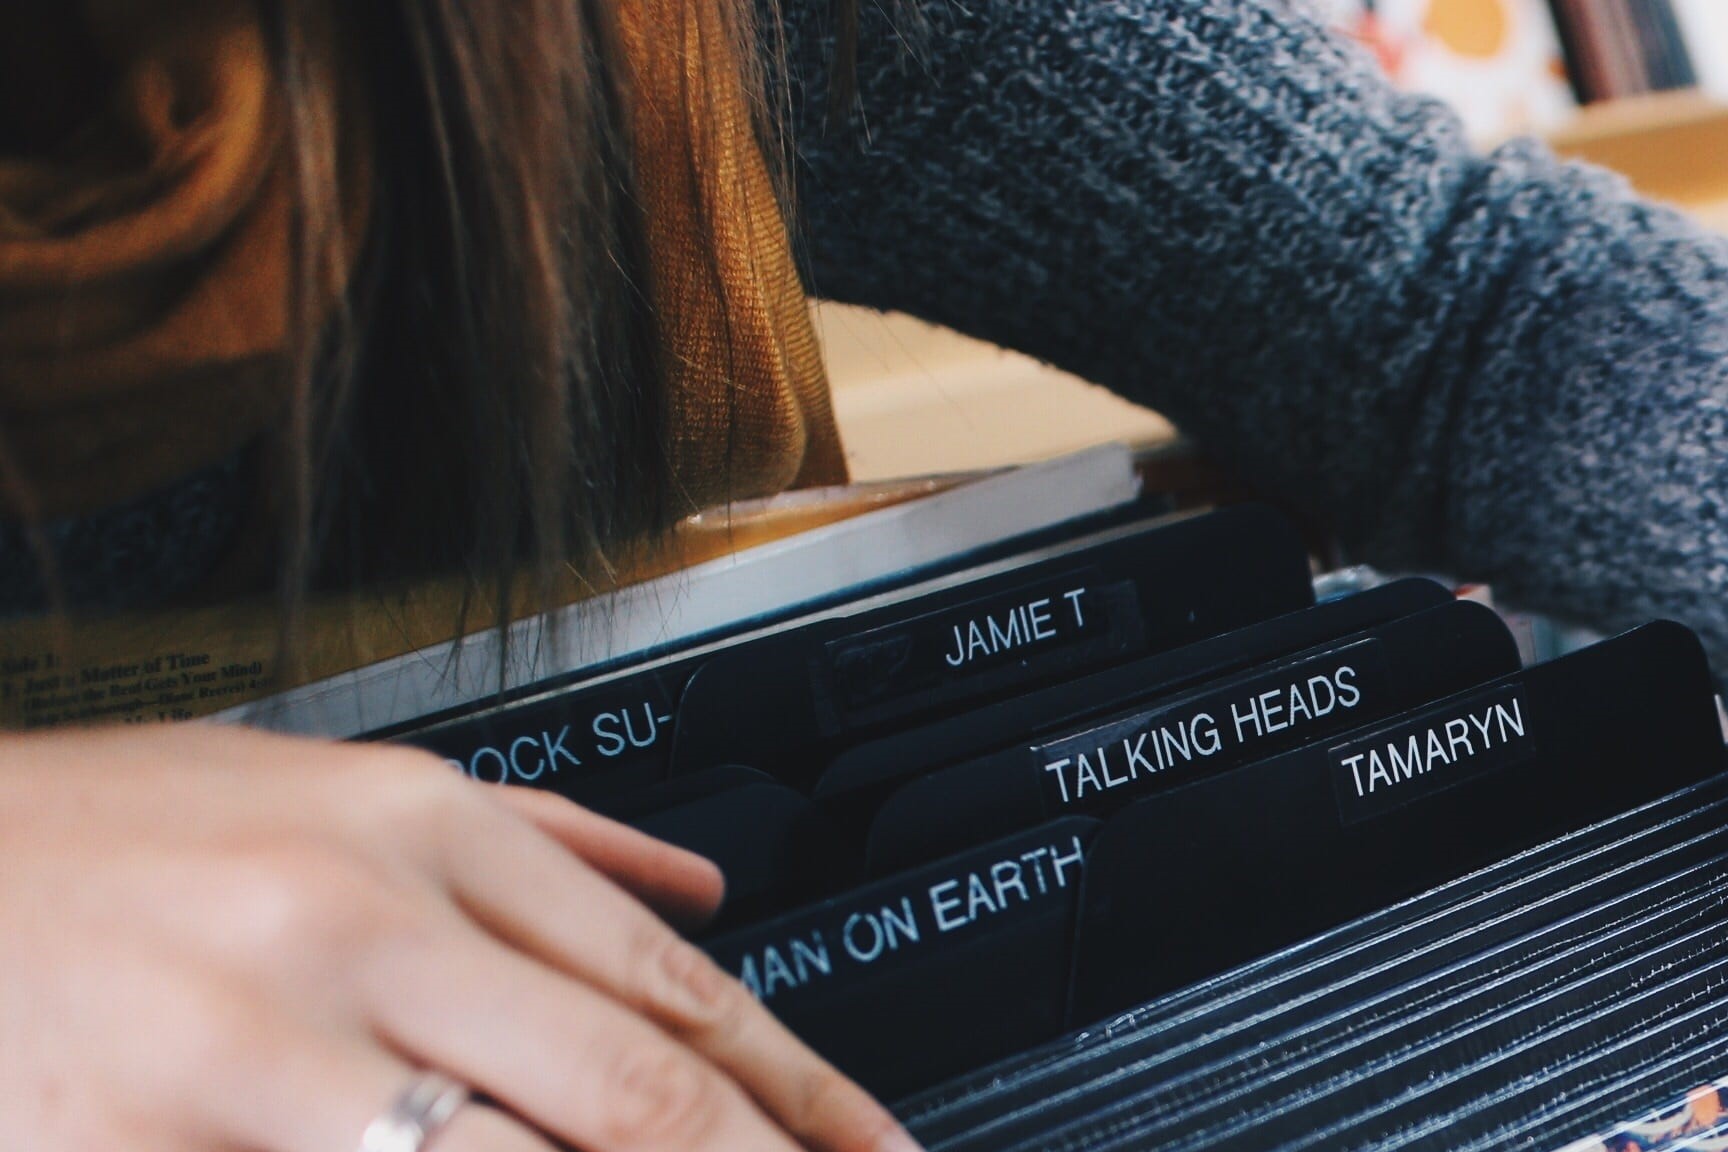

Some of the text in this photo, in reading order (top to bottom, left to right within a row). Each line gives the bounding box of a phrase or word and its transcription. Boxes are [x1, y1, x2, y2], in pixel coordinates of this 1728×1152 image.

[166, 653, 210, 671] Time
[945, 588, 1088, 667] JAMIE T
[593, 702, 673, 757] SU-
[1045, 665, 1362, 804] TALKING HEADS
[1341, 697, 1526, 797] TAMARYN
[843, 896, 919, 963] ON
[928, 835, 1085, 932] EARTH
